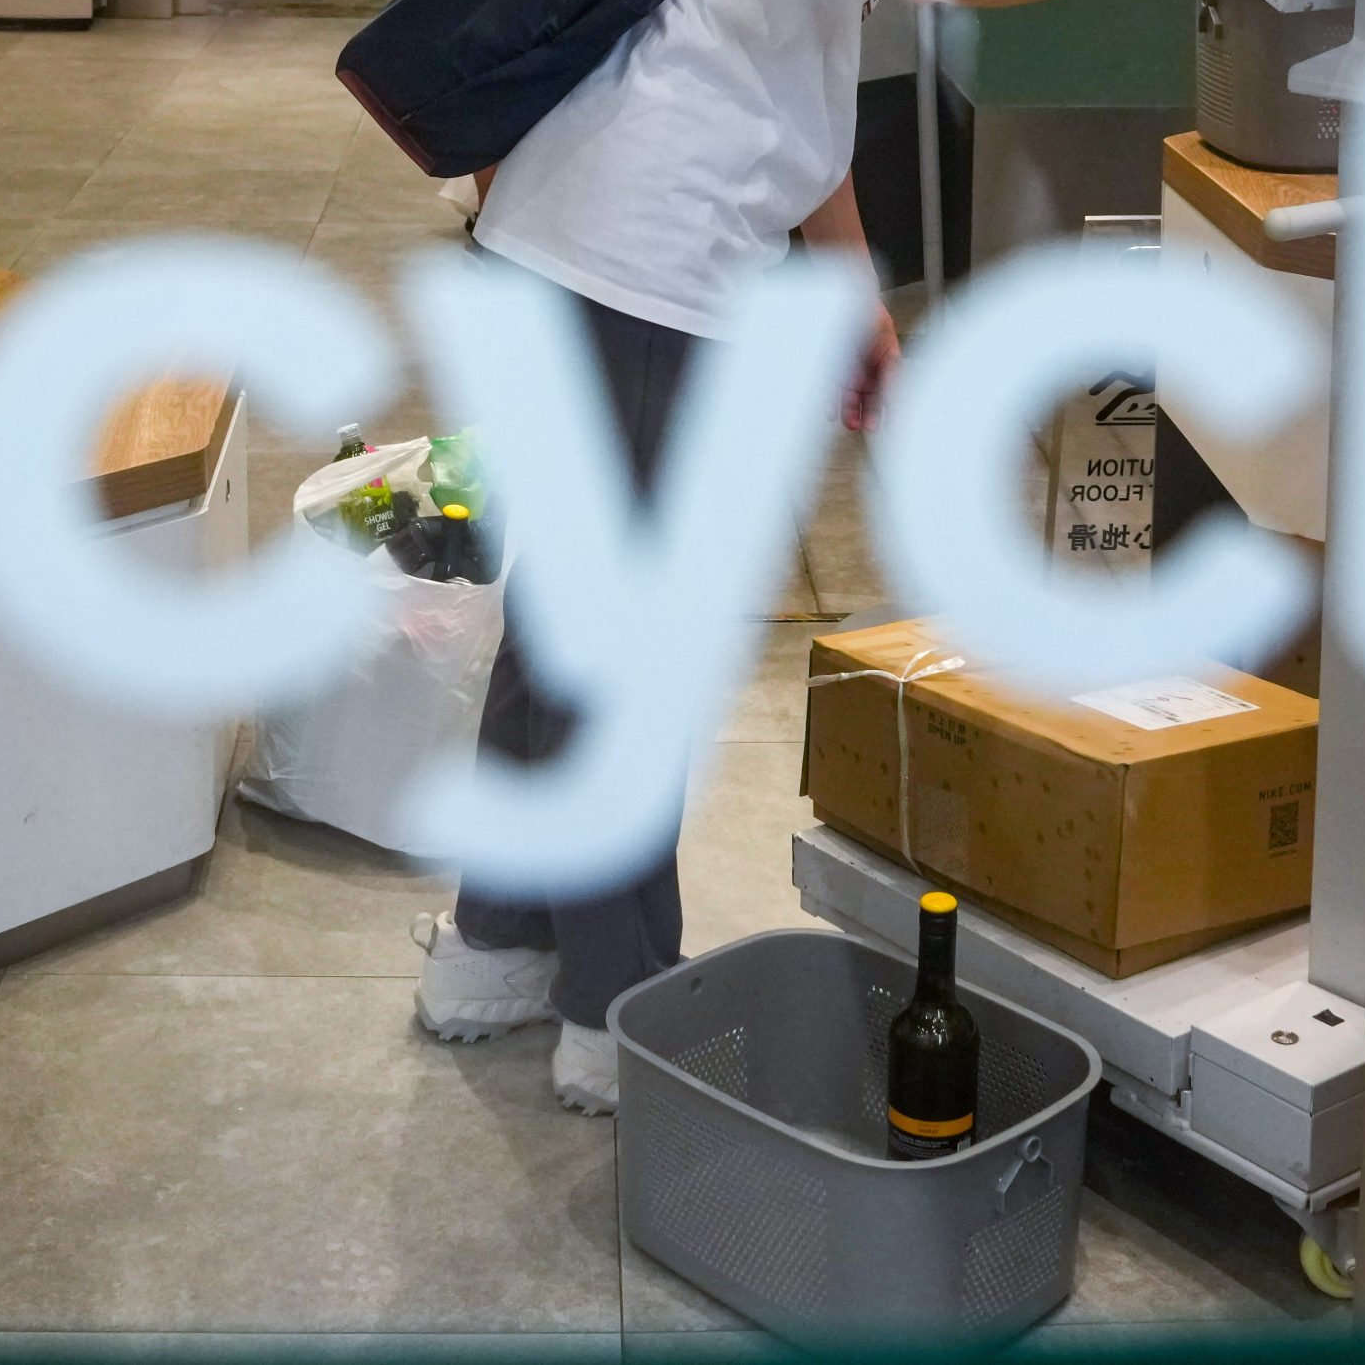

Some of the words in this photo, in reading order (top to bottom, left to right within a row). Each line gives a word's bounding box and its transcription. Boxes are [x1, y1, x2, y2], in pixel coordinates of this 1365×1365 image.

[376, 522, 391, 533] GEL
[928, 722, 951, 741] OPEN
[954, 735, 966, 745] UP
[1258, 780, 1313, 801] NIKE.COM
